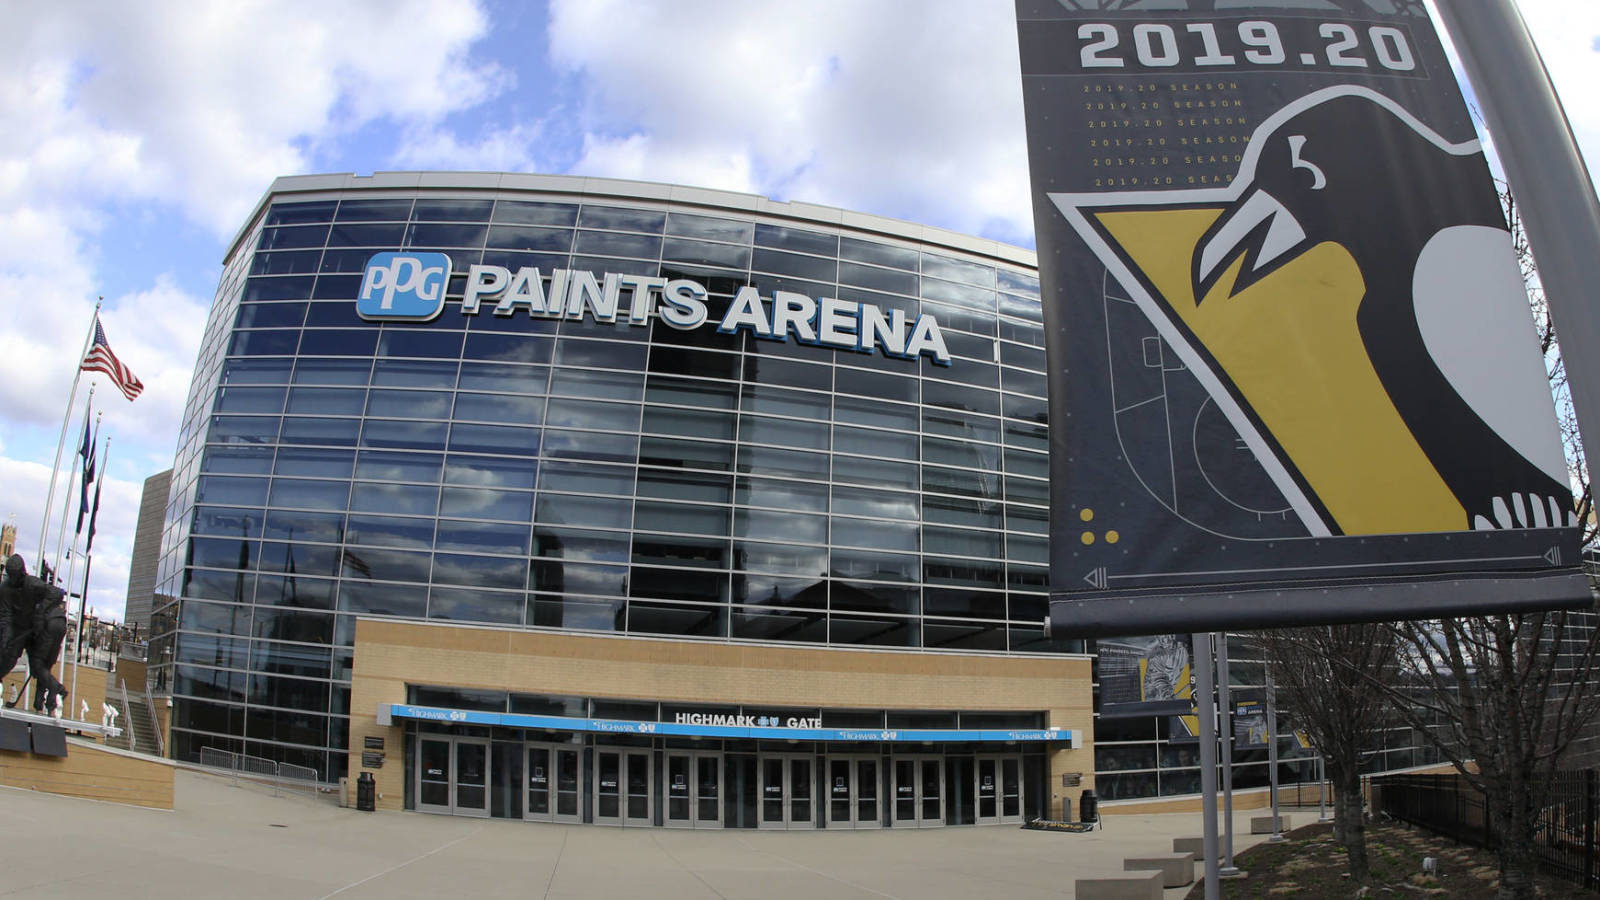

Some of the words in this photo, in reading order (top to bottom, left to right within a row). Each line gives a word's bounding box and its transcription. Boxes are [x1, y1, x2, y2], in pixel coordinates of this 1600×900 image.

[1078, 20, 1416, 71] 2019.20
[1083, 84, 1156, 93] 2019.20
[1170, 82, 1238, 92] SEASON
[1086, 102, 1160, 111] 2019.20
[1174, 100, 1242, 109] SEASON
[1088, 119, 1163, 129] 2019.20
[1177, 117, 1246, 127] SEASON
[1090, 138, 1167, 147] 2019.20
[1181, 136, 1250, 145] SEASON
[1093, 157, 1169, 167] 2019.20
[1095, 177, 1173, 187] 2019.20
[361, 256, 444, 310] PPG
[460, 263, 709, 331] PAINTS
[716, 285, 952, 367] ARENA
[675, 712, 757, 728] HIGHMARK
[786, 717, 823, 729] GATE
